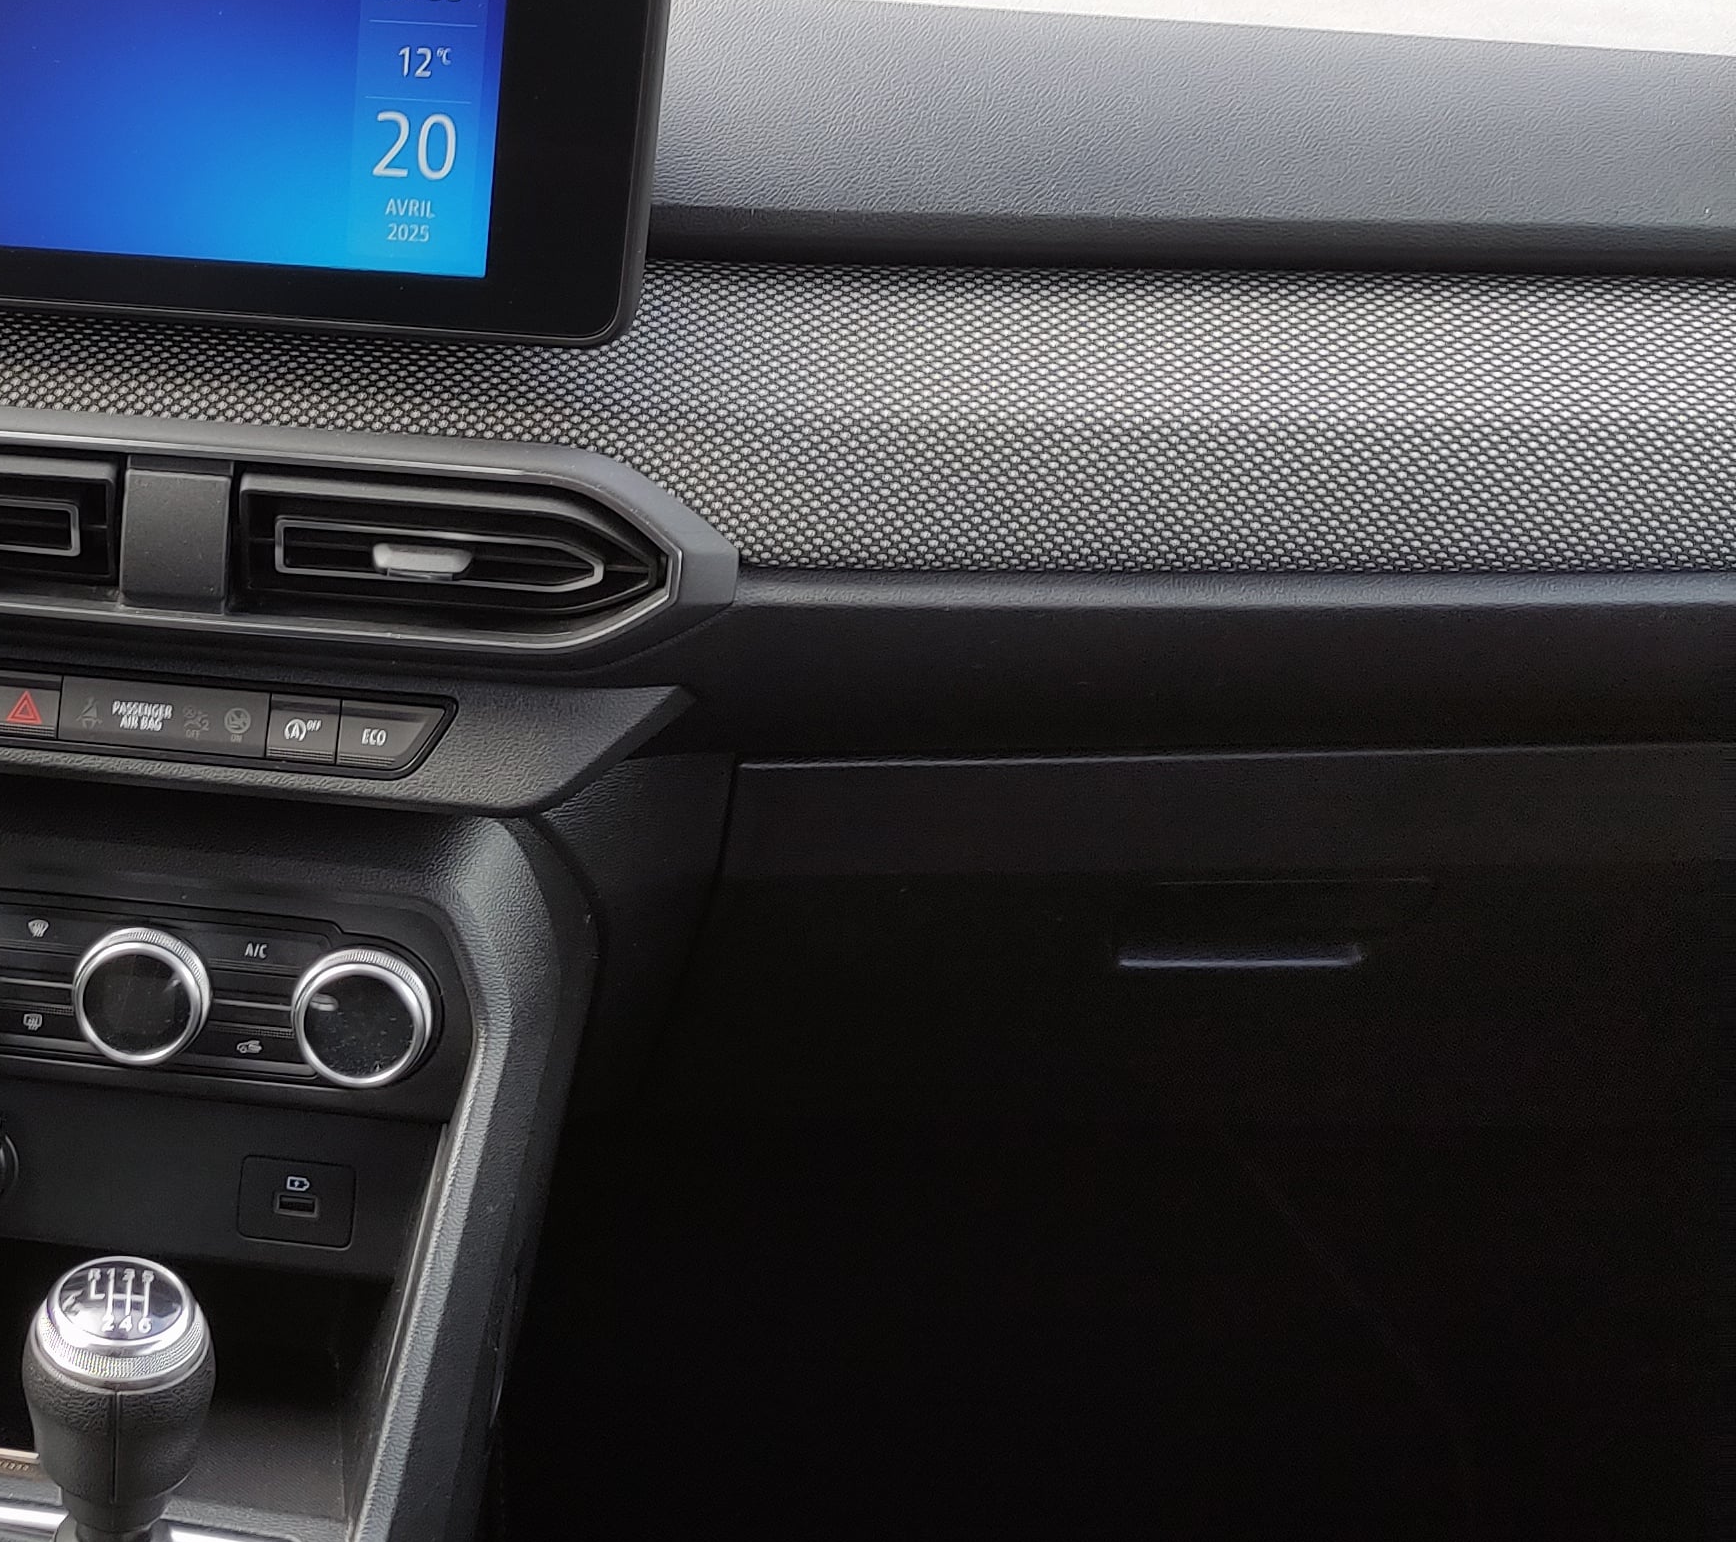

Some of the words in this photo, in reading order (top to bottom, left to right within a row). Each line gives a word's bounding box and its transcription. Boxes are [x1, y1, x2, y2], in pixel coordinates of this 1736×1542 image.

[372, 110, 457, 181] 20
[385, 198, 435, 219] AVRIL
[386, 223, 430, 242] 2025
[112, 700, 173, 720] PASSENGER
[139, 716, 163, 732] BAG
[361, 728, 386, 746] ECO
[244, 942, 268, 959] A/C
